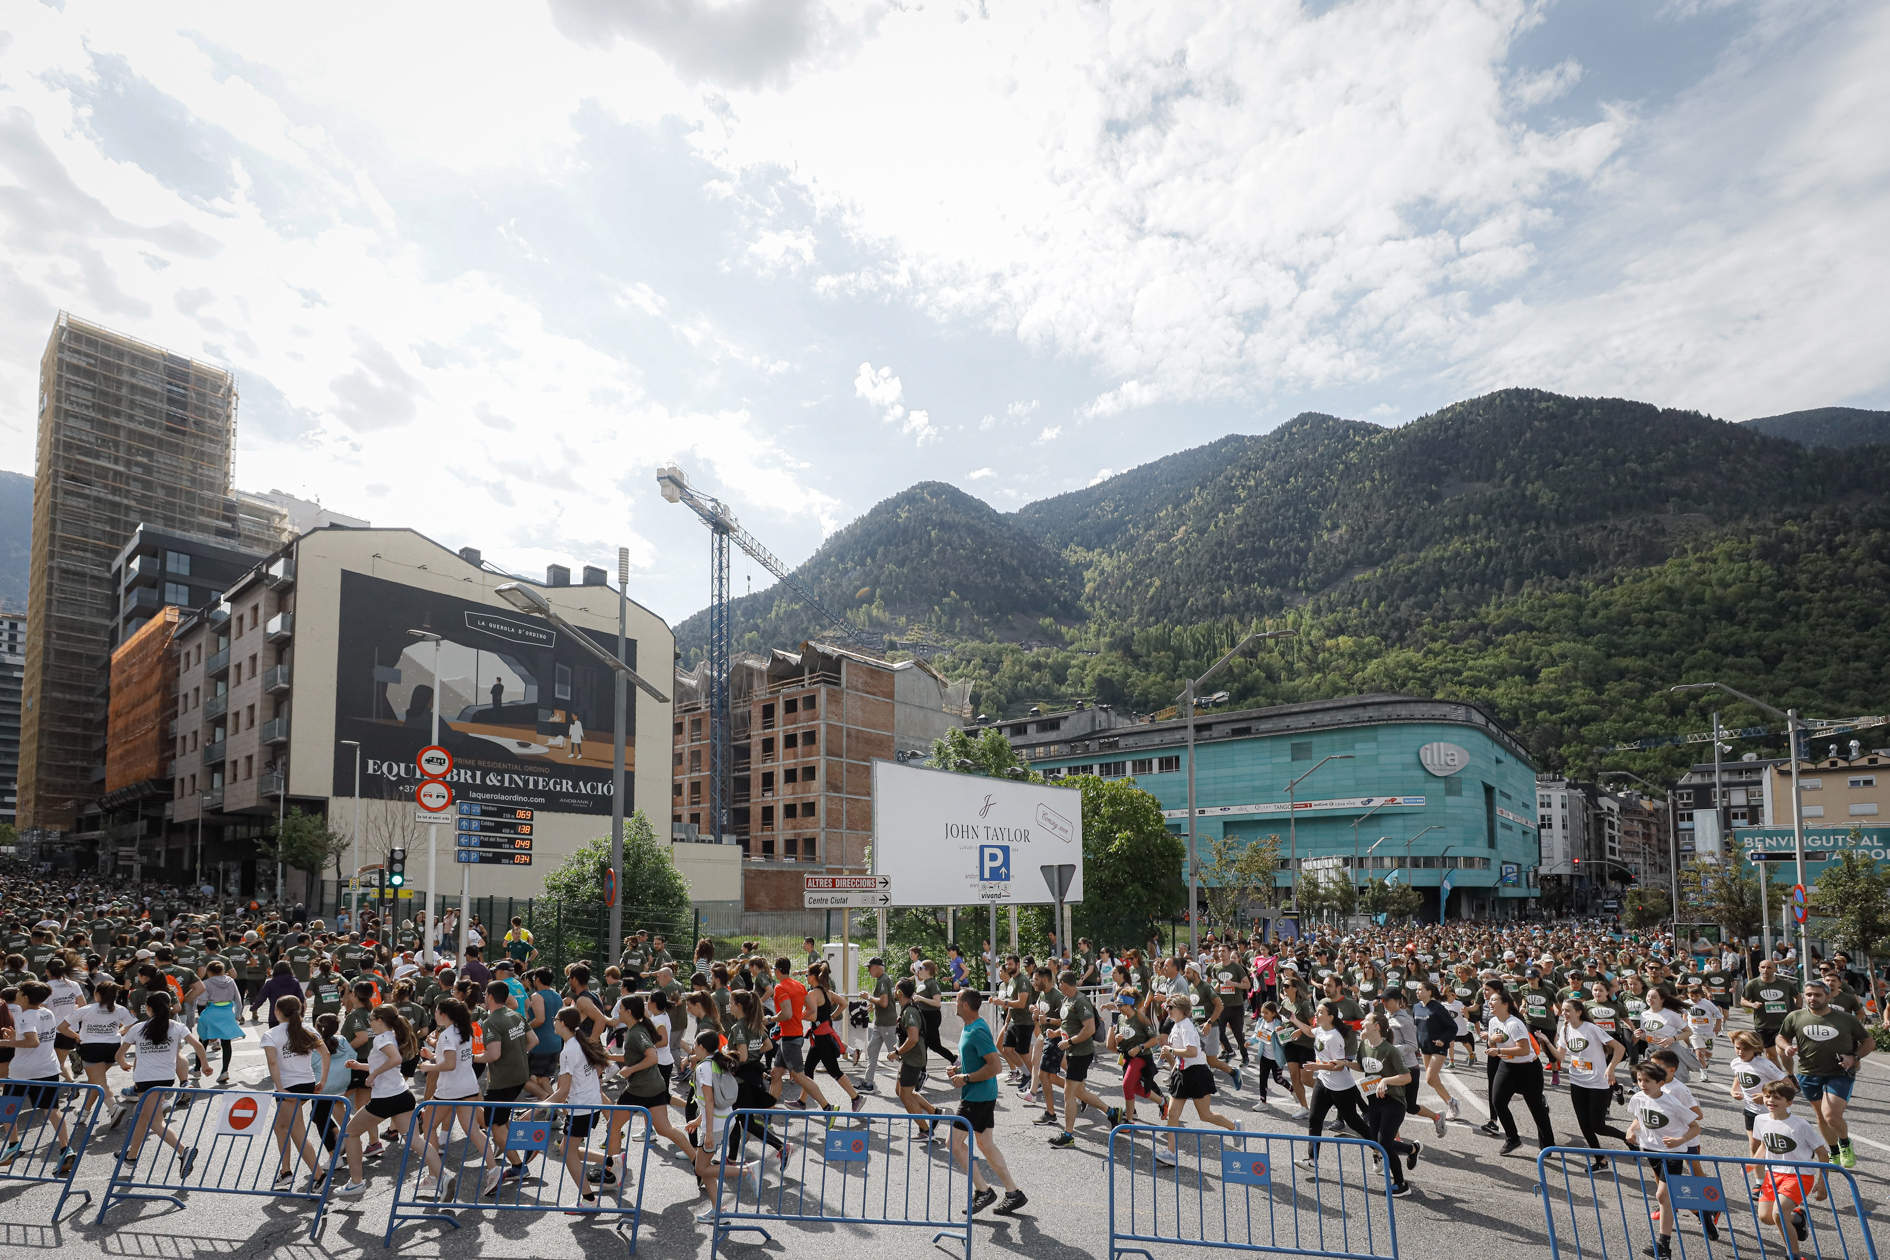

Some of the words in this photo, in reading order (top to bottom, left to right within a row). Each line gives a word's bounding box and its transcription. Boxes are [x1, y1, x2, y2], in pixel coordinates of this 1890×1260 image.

[488, 622, 514, 632] QUEROLA
[518, 629, 546, 640] D'ORDINO
[1425, 742, 1458, 766] illa
[454, 758, 476, 766] PRIME
[478, 760, 522, 772] RESIDENTIAL
[524, 765, 550, 774] ORDINO
[366, 758, 482, 784] EQUIBRI
[504, 773, 614, 796] INTEGRACIÓ
[469, 790, 545, 804] laquerolaordino.com
[516, 810, 531, 819] 069
[518, 825, 531, 834] 138
[945, 823, 979, 840] JOHN
[984, 826, 1030, 843] TAYLOR
[515, 840, 530, 848] 049
[1744, 835, 1856, 848] BENVIGUTS
[1860, 835, 1883, 846] AL
[514, 855, 530, 864] 034
[984, 848, 1004, 878] P
[807, 879, 832, 888] ALTRES
[836, 879, 876, 888] DIRECCIONS
[1762, 989, 1778, 998] illa
[1807, 1025, 1830, 1036] illa
[1764, 1133, 1787, 1149] illa
